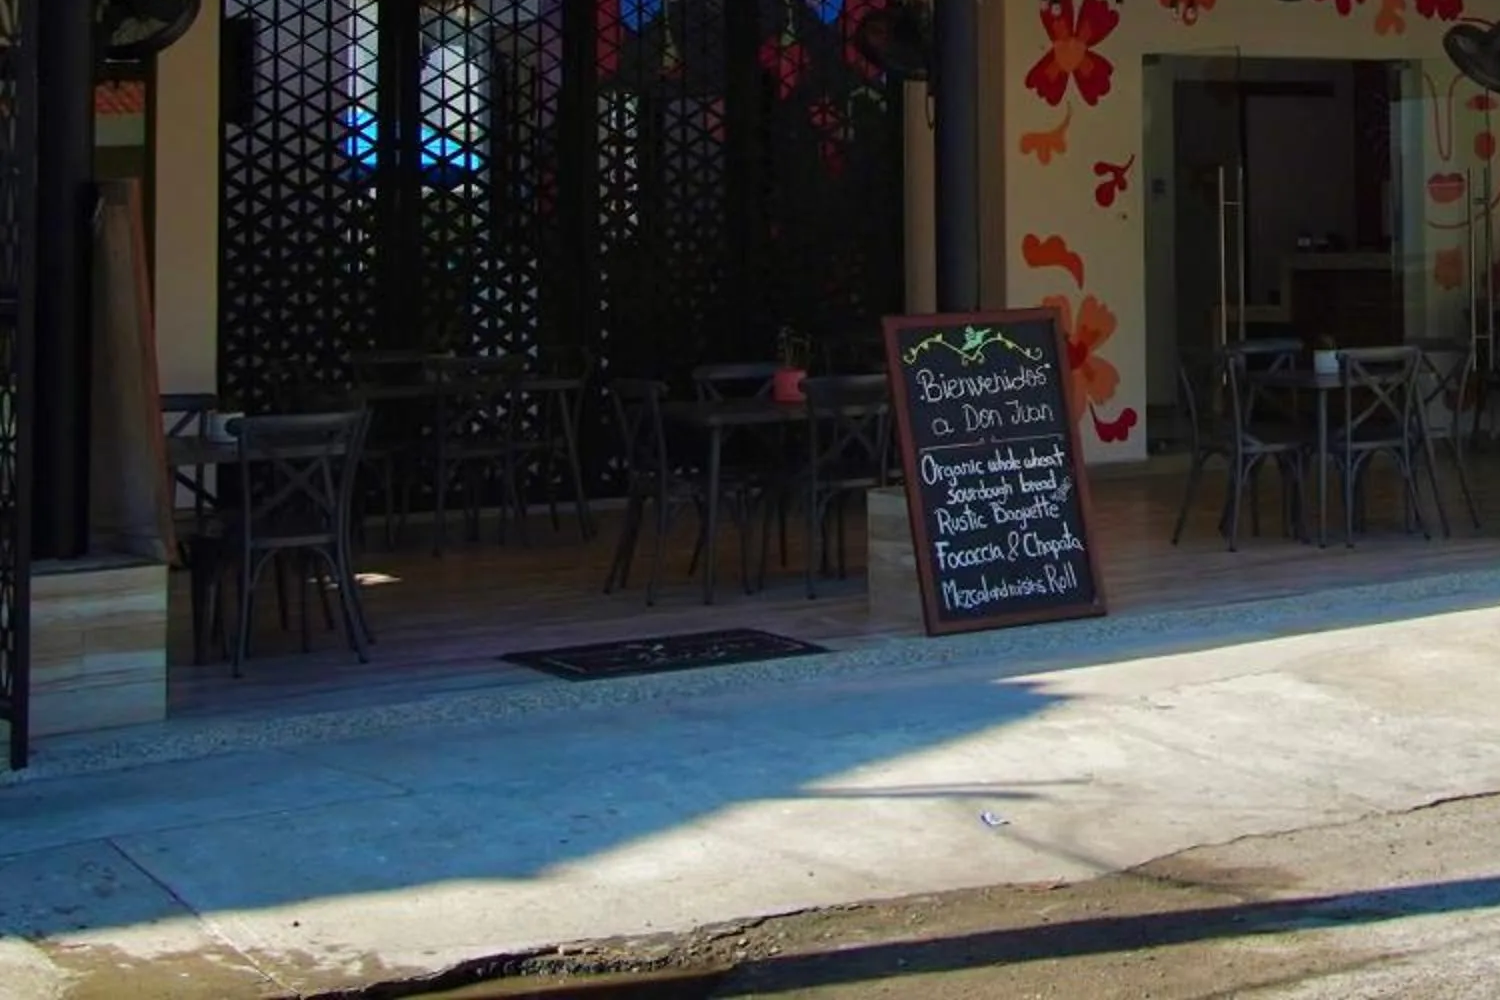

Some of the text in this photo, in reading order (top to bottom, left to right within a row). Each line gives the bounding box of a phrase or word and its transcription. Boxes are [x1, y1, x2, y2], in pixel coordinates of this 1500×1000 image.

[916, 365, 1047, 402] Bienvenidos
[931, 400, 1054, 435] a Don Juan
[921, 445, 1065, 487] Organic whole wheat
[946, 469, 1057, 505] sourdough bread
[934, 495, 1060, 535] Rustic Baguette
[934, 541, 1005, 571] Focaccia
[1023, 521, 1085, 560] Chapata
[1043, 560, 1079, 595] Roll
